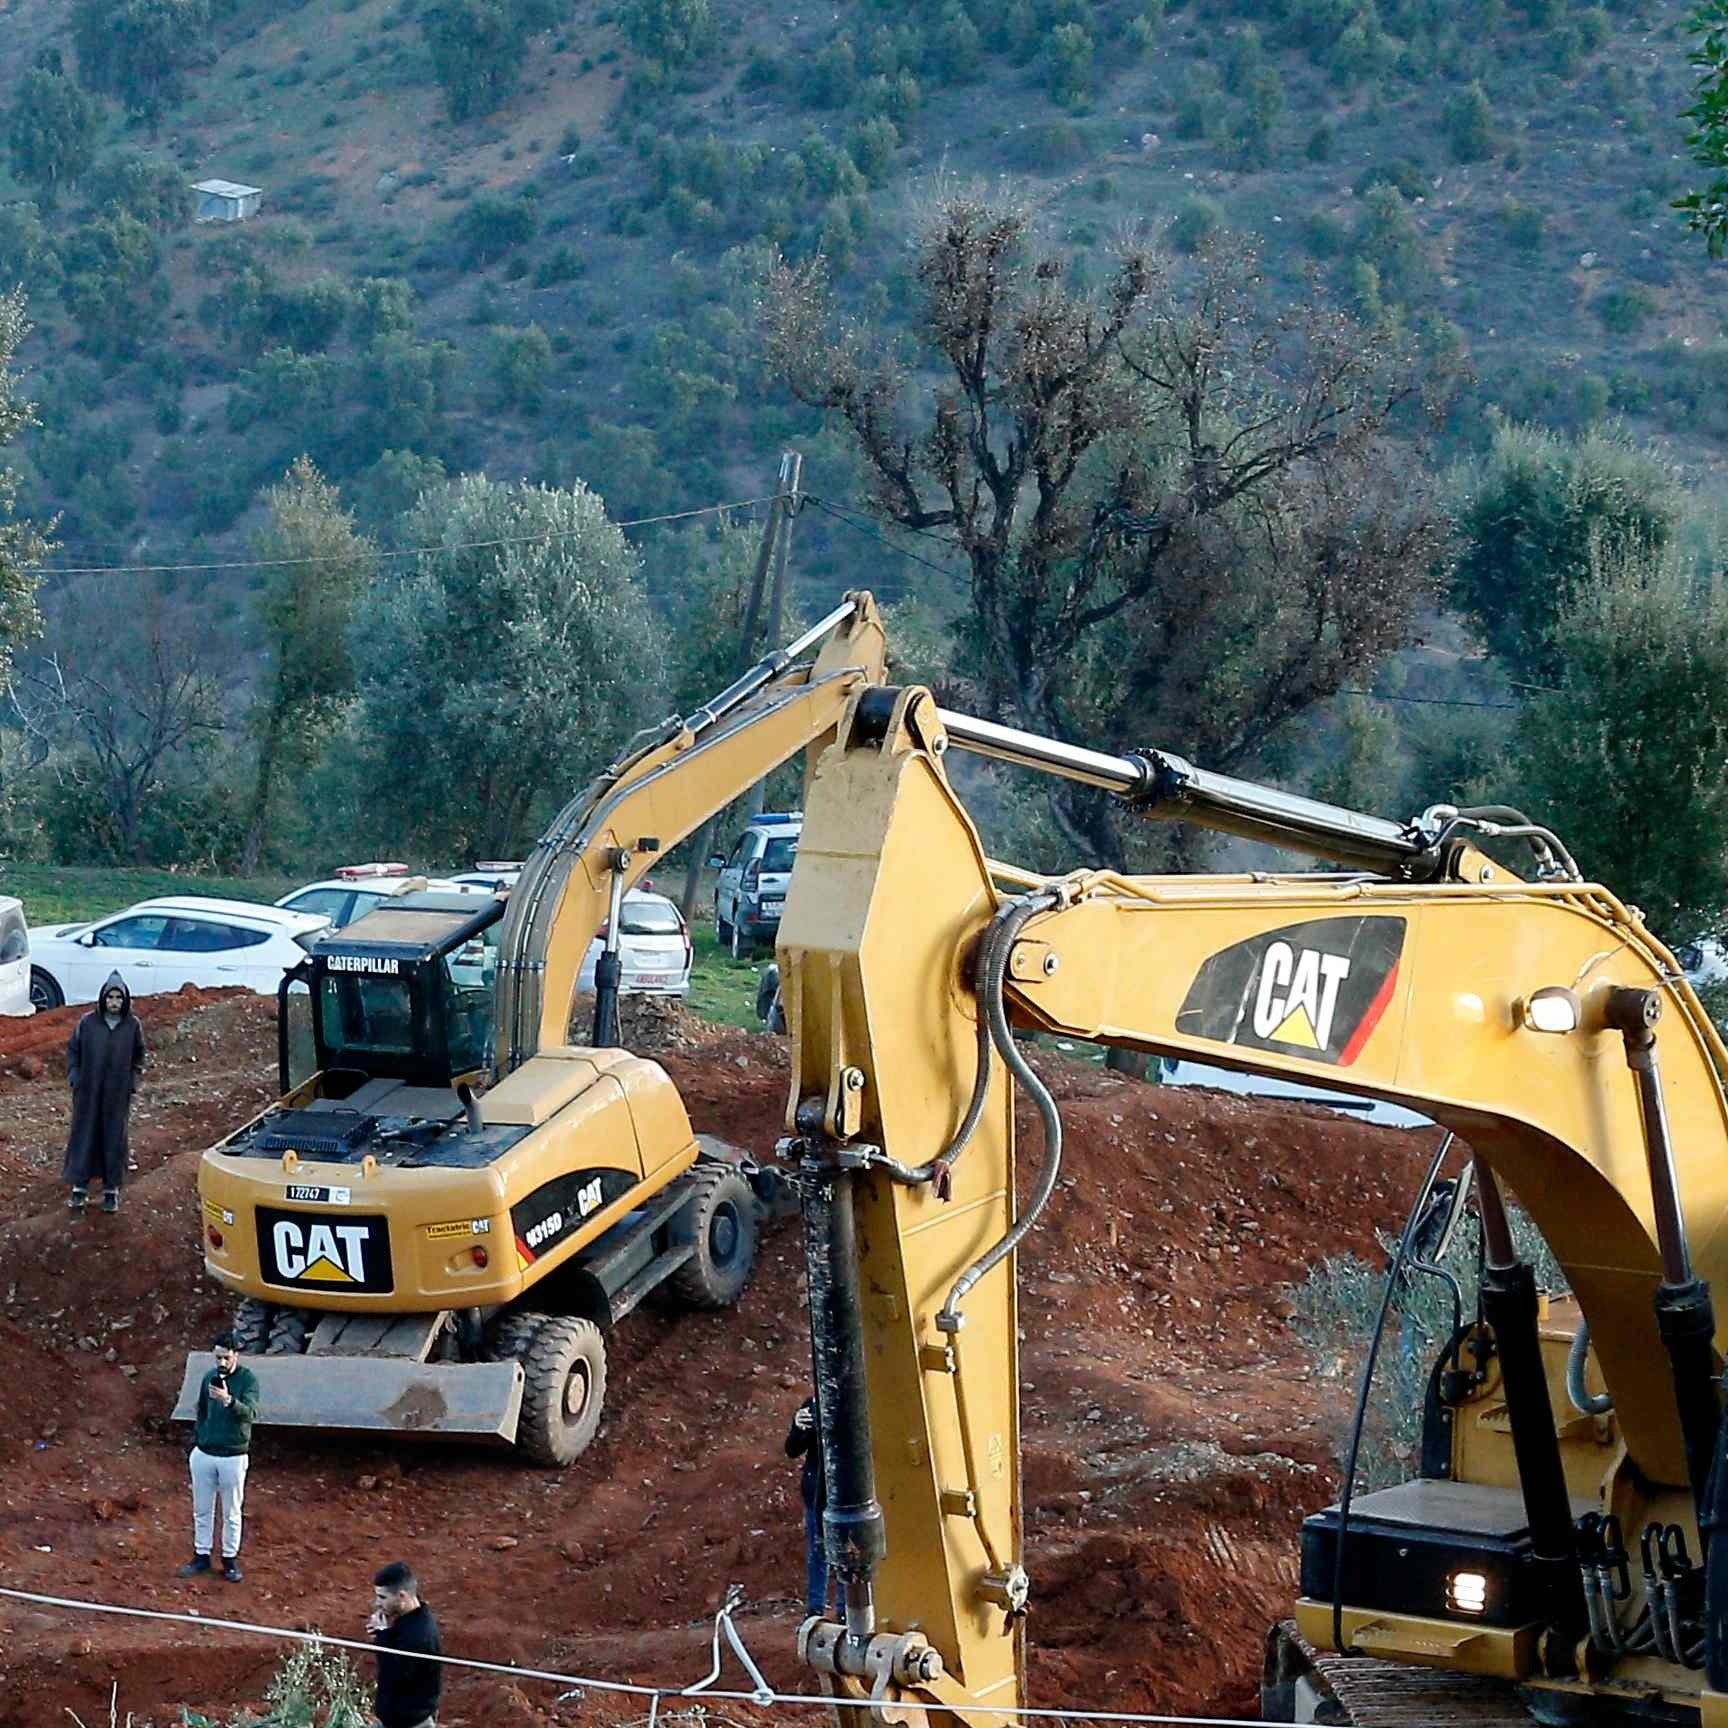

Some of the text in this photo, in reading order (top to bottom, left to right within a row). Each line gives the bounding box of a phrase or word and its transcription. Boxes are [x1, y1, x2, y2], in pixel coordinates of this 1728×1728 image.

[327, 955, 399, 974] CATERPILLAR
[1254, 941, 1351, 1052] CAT
[576, 1176, 603, 1217] CAT
[472, 1219, 489, 1234] CAT
[272, 1220, 370, 1282] CAT
